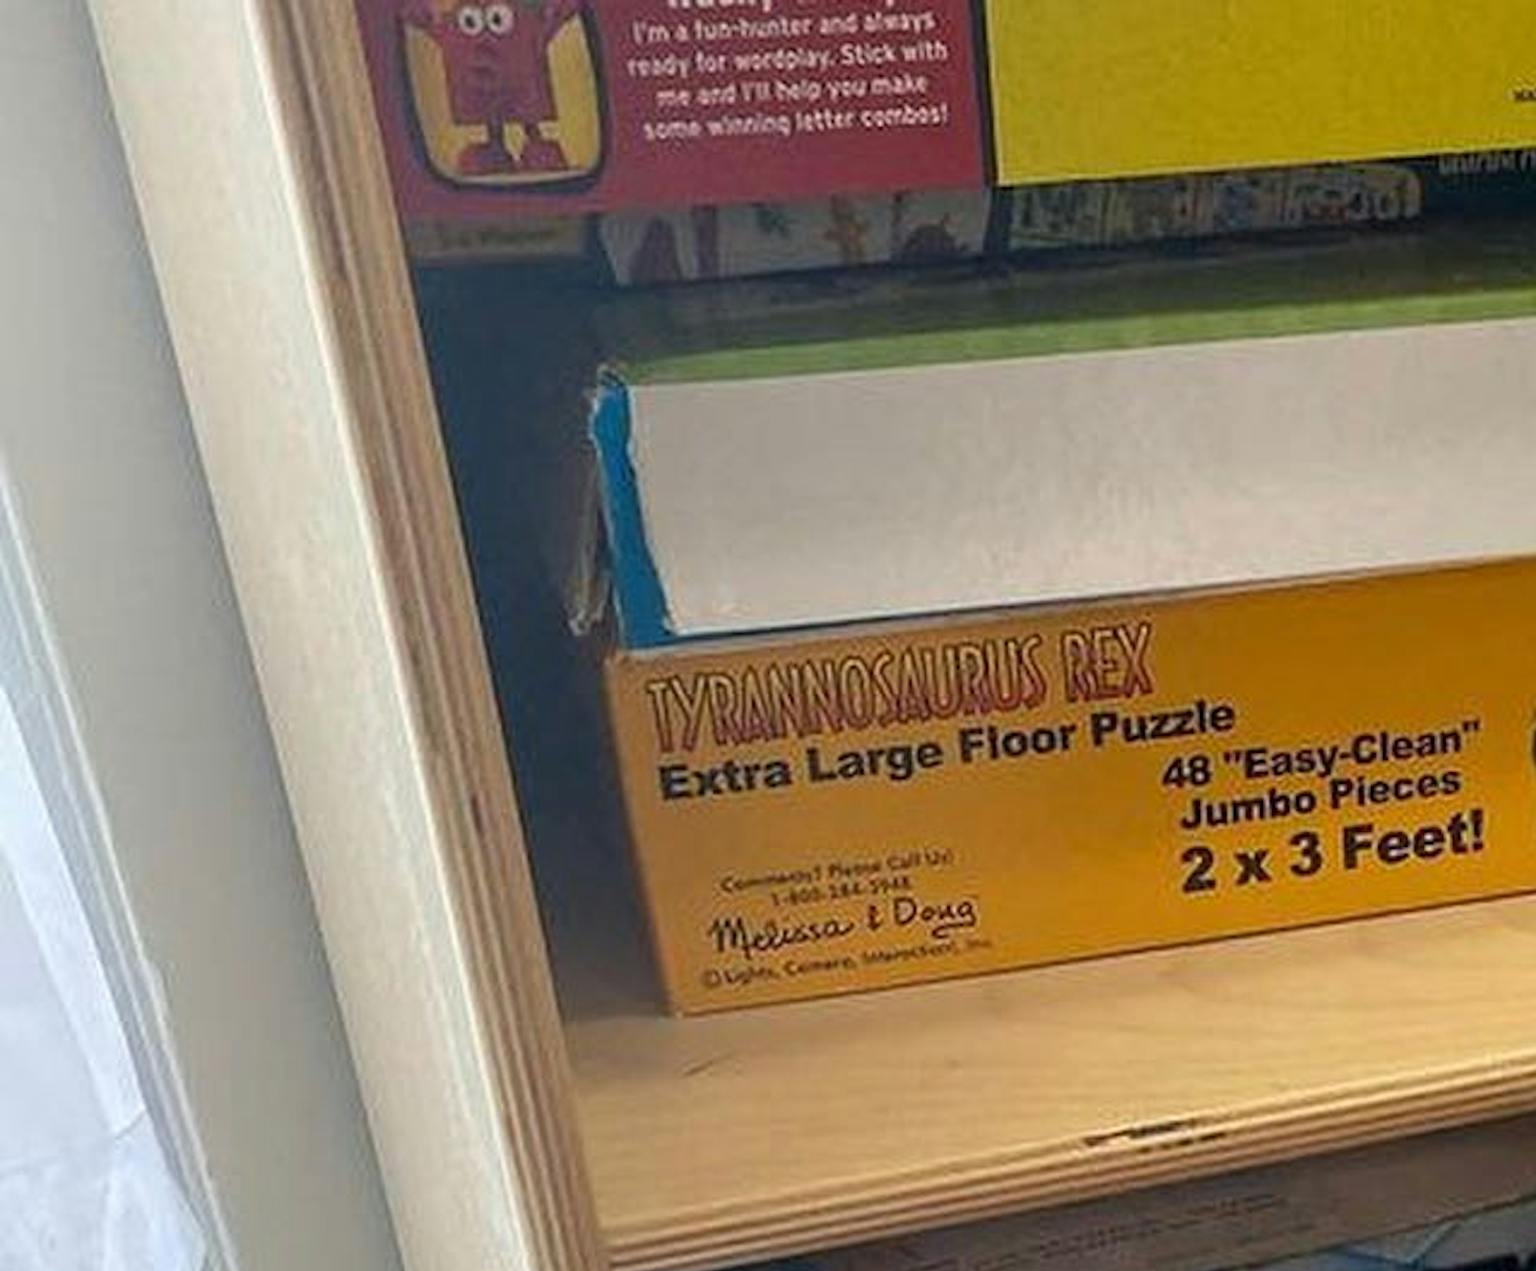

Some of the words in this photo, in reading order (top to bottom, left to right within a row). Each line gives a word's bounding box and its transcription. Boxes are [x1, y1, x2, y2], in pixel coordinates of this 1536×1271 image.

[632, 21, 670, 45] I'm
[676, 24, 689, 41] a
[694, 16, 812, 41] fun-hunter
[820, 14, 857, 35] and
[864, 10, 936, 33] always
[627, 55, 690, 79] ready
[696, 52, 728, 73] for
[840, 43, 896, 66] Stick
[904, 40, 948, 63] with
[656, 89, 690, 107] me
[696, 84, 736, 106] and
[741, 81, 769, 103] I'll
[775, 79, 821, 102] help
[827, 77, 866, 100] you
[871, 72, 929, 94] make
[643, 119, 701, 140] some
[706, 110, 791, 137] winning
[795, 106, 854, 131] letter
[860, 103, 948, 128] combos!
[647, 635, 1047, 752] TYRANNOSAURUS
[1062, 623, 1152, 701] REX
[658, 758, 792, 801] Extra
[806, 740, 943, 781] Large
[960, 720, 1076, 763] Floor
[1092, 700, 1235, 746] Puzzle
[1162, 755, 1211, 788] 48
[1222, 720, 1480, 779] "Easy-Clean"
[1180, 789, 1317, 829] Jumbo
[1330, 771, 1461, 809] Pieces
[886, 850, 922, 871] Call
[1181, 846, 1216, 892] 2
[1236, 850, 1271, 885] x
[1290, 832, 1322, 876] 3
[1343, 809, 1484, 870] Feet!
[707, 915, 854, 960] Melissa
[894, 897, 978, 939] Doug
